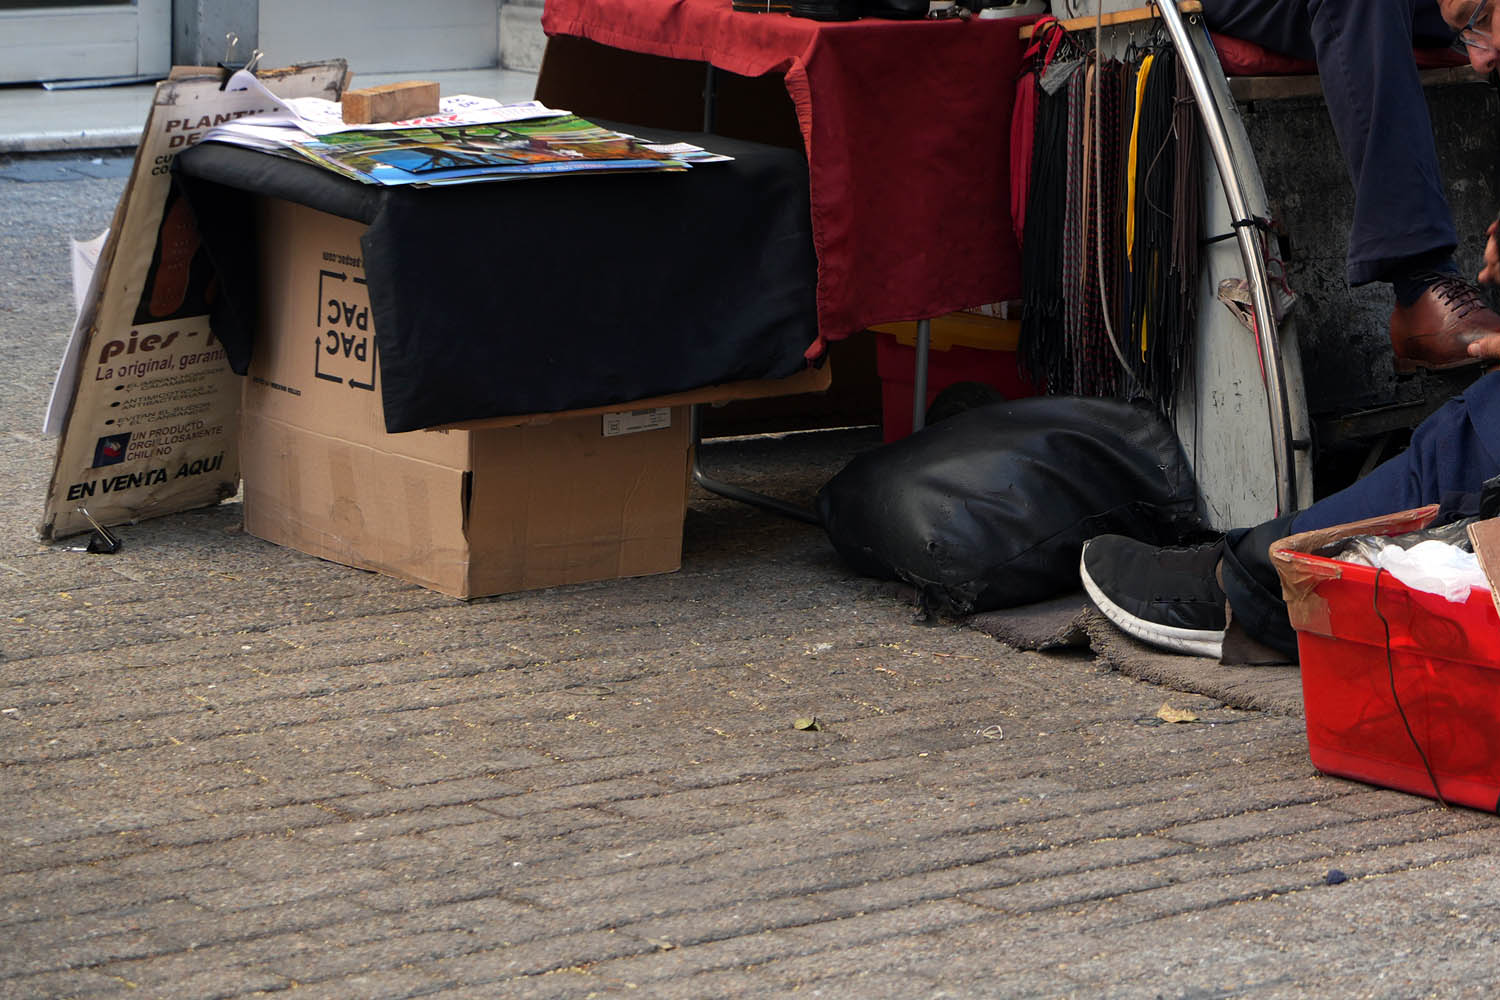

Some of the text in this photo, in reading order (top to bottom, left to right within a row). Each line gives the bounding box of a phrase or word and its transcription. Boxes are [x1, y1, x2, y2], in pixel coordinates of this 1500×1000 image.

[327, 299, 369, 331] PAC
[98, 330, 180, 364] pies
[326, 330, 367, 362] PAC
[95, 367, 114, 381] La
[118, 355, 175, 378] original,
[131, 420, 204, 441] UN PRODUCTO
[67, 451, 225, 501] EN VENTA AQUÍ
